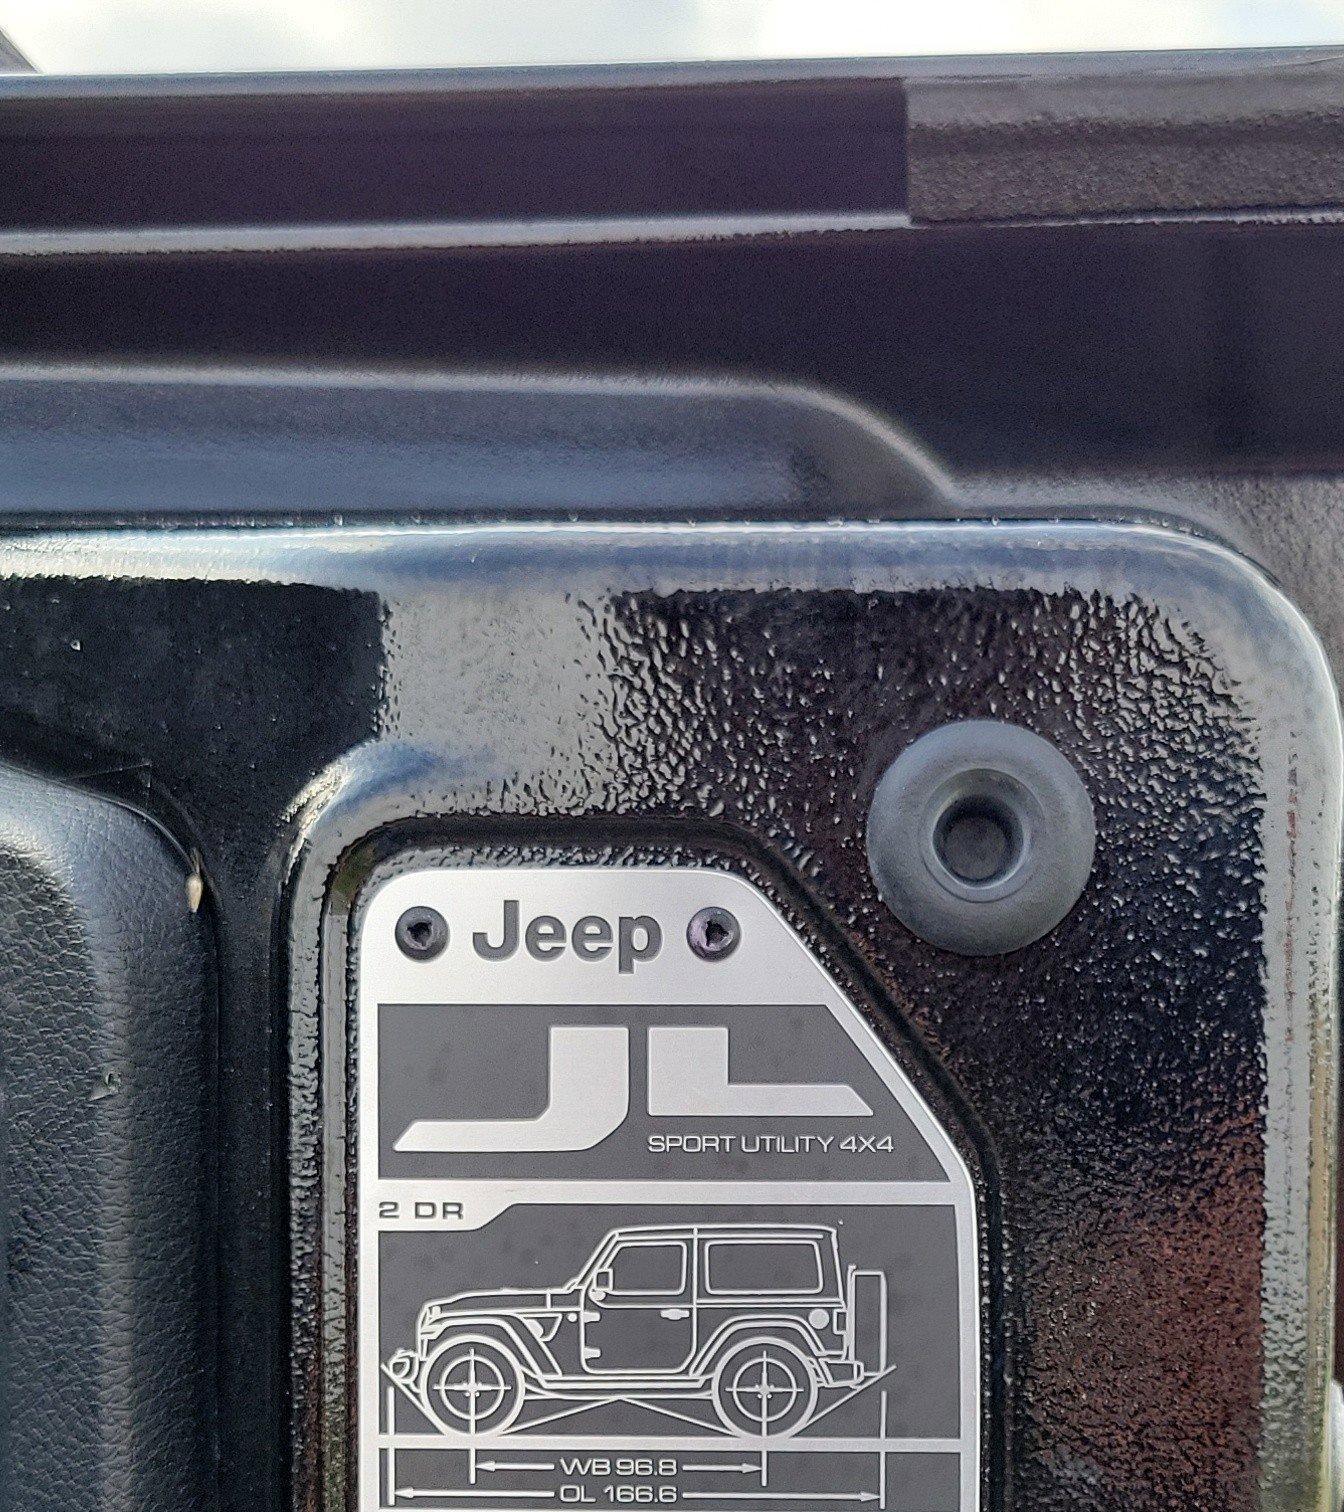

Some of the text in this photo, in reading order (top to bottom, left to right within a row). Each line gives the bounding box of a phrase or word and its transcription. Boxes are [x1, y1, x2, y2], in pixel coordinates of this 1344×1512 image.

[471, 899, 663, 975] Jeep
[647, 1135, 895, 1154] SPORT UTILITY 4X4
[378, 1201, 464, 1219] 2 DR
[559, 1457, 678, 1476] WB 96.8
[559, 1484, 678, 1503] OL 166.6
